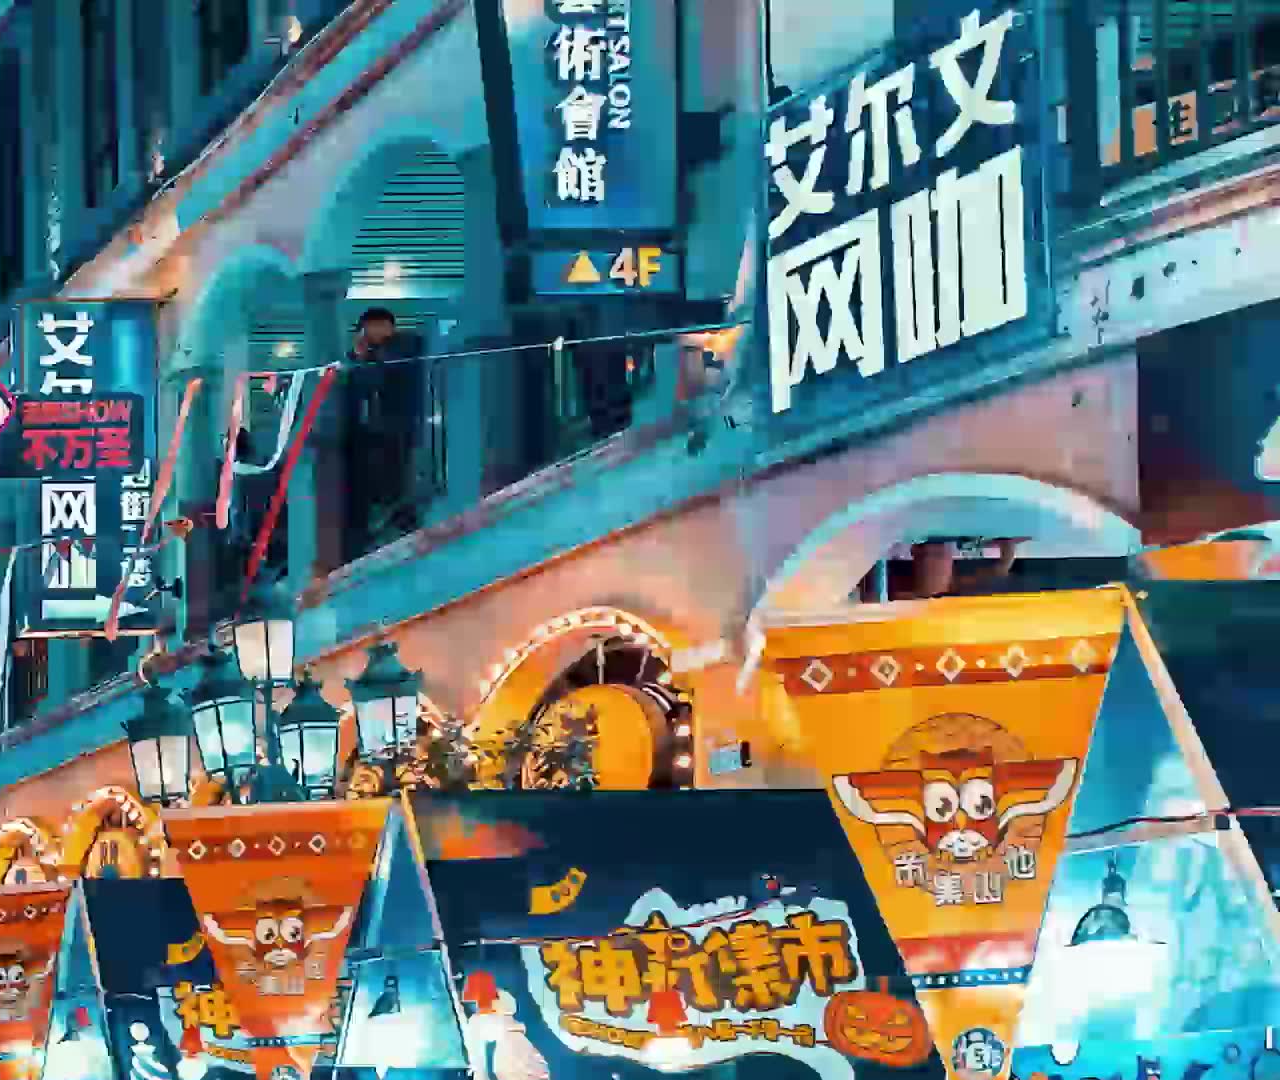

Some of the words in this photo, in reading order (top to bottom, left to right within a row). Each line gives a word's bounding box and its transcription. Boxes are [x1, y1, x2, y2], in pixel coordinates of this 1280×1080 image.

[608, 35, 632, 129] SALON
[766, 8, 1017, 239] 艾尔文
[608, 247, 662, 287] 4F
[767, 147, 1028, 413] 网咖
[22, 428, 132, 469] 不万圣
